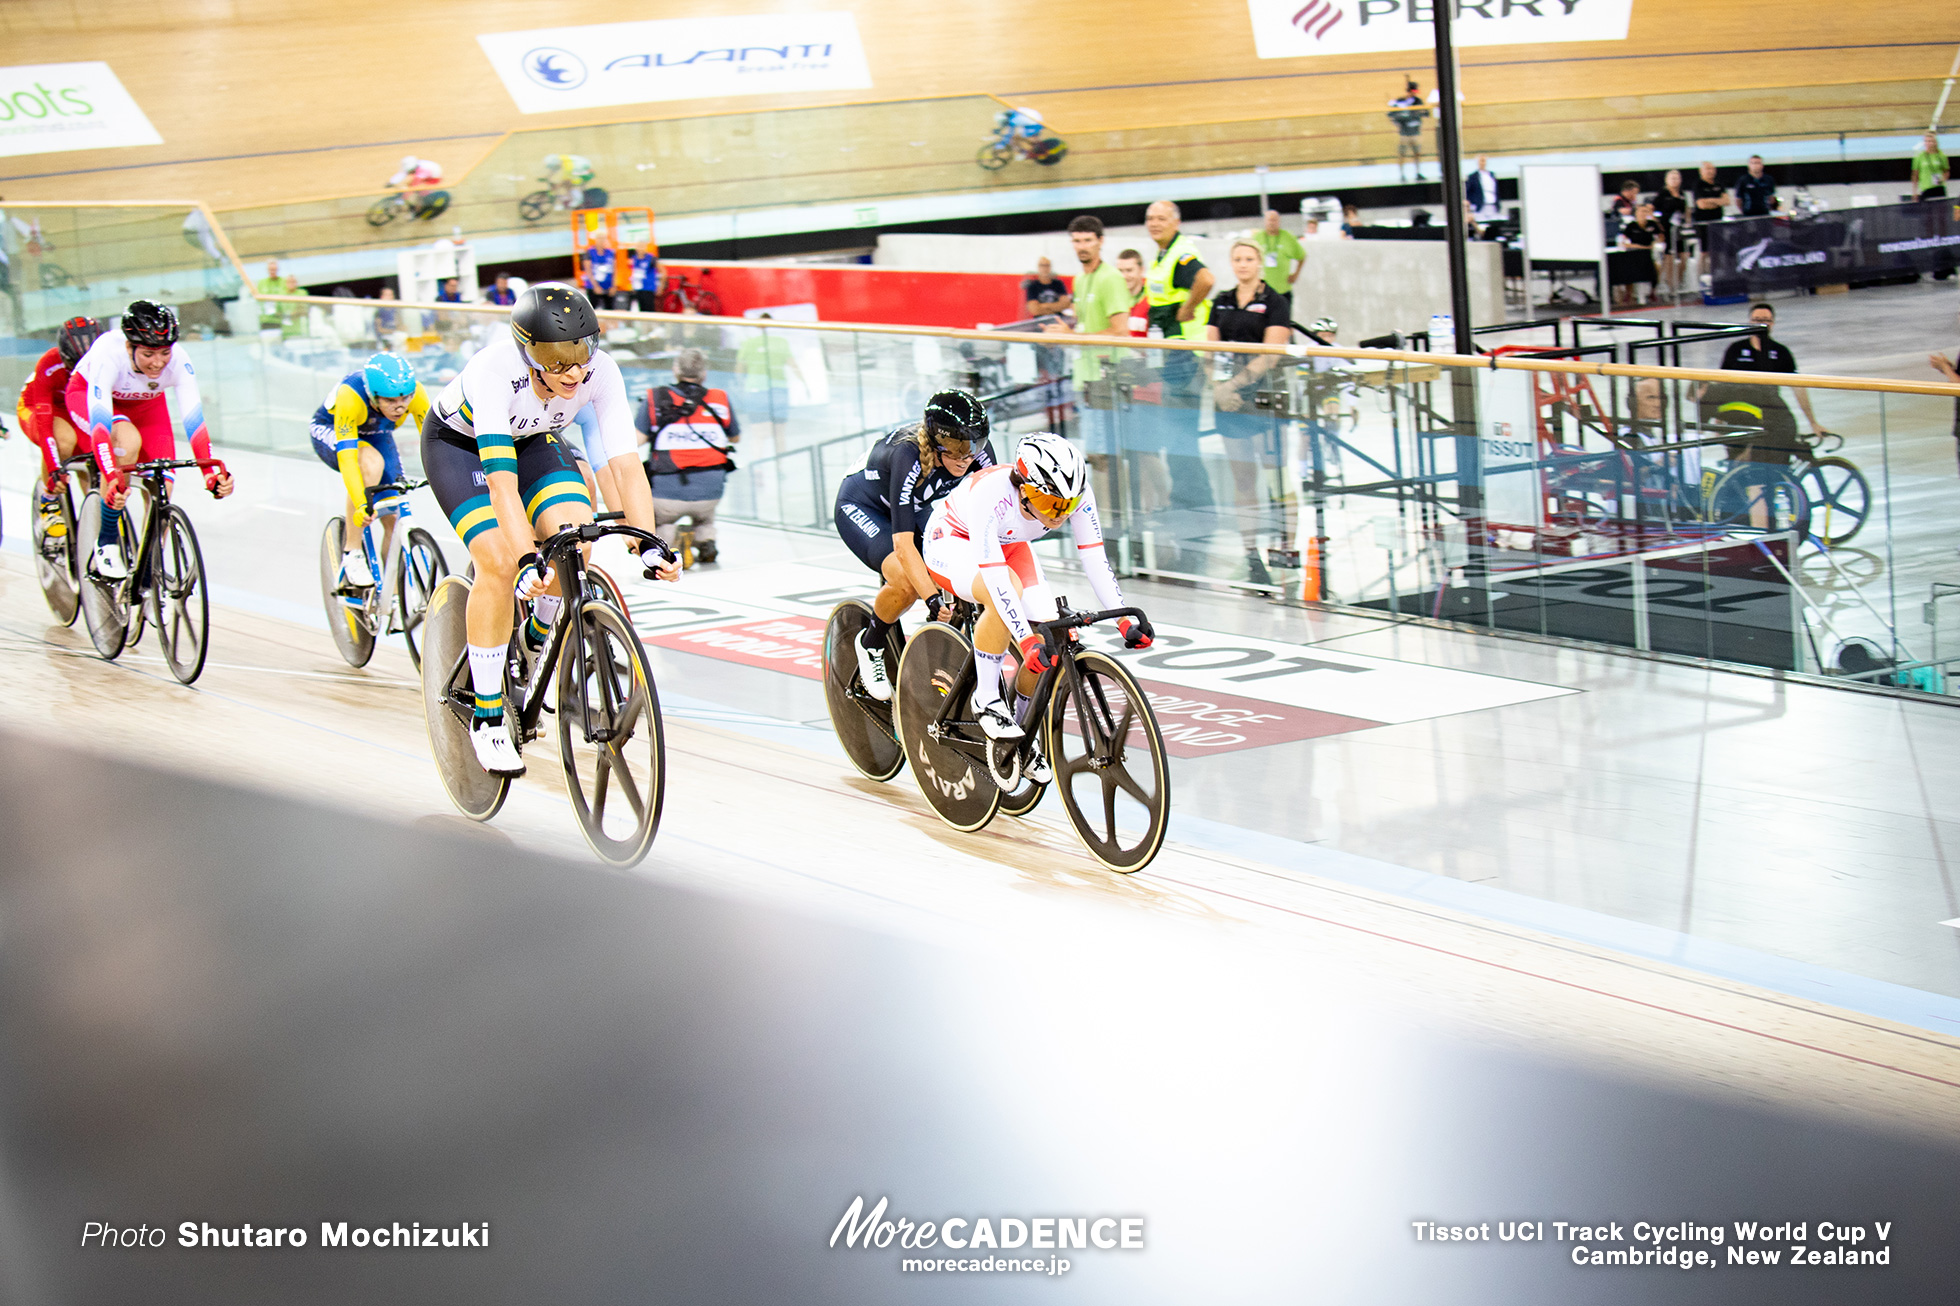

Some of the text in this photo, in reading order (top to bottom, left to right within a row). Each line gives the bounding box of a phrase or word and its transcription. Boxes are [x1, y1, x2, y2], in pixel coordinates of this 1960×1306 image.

[97, 442, 115, 475] RUSSIA
[1480, 438, 1533, 459] TISSOT
[849, 508, 881, 538] ZEALAND
[996, 586, 1026, 638] JAPAN
